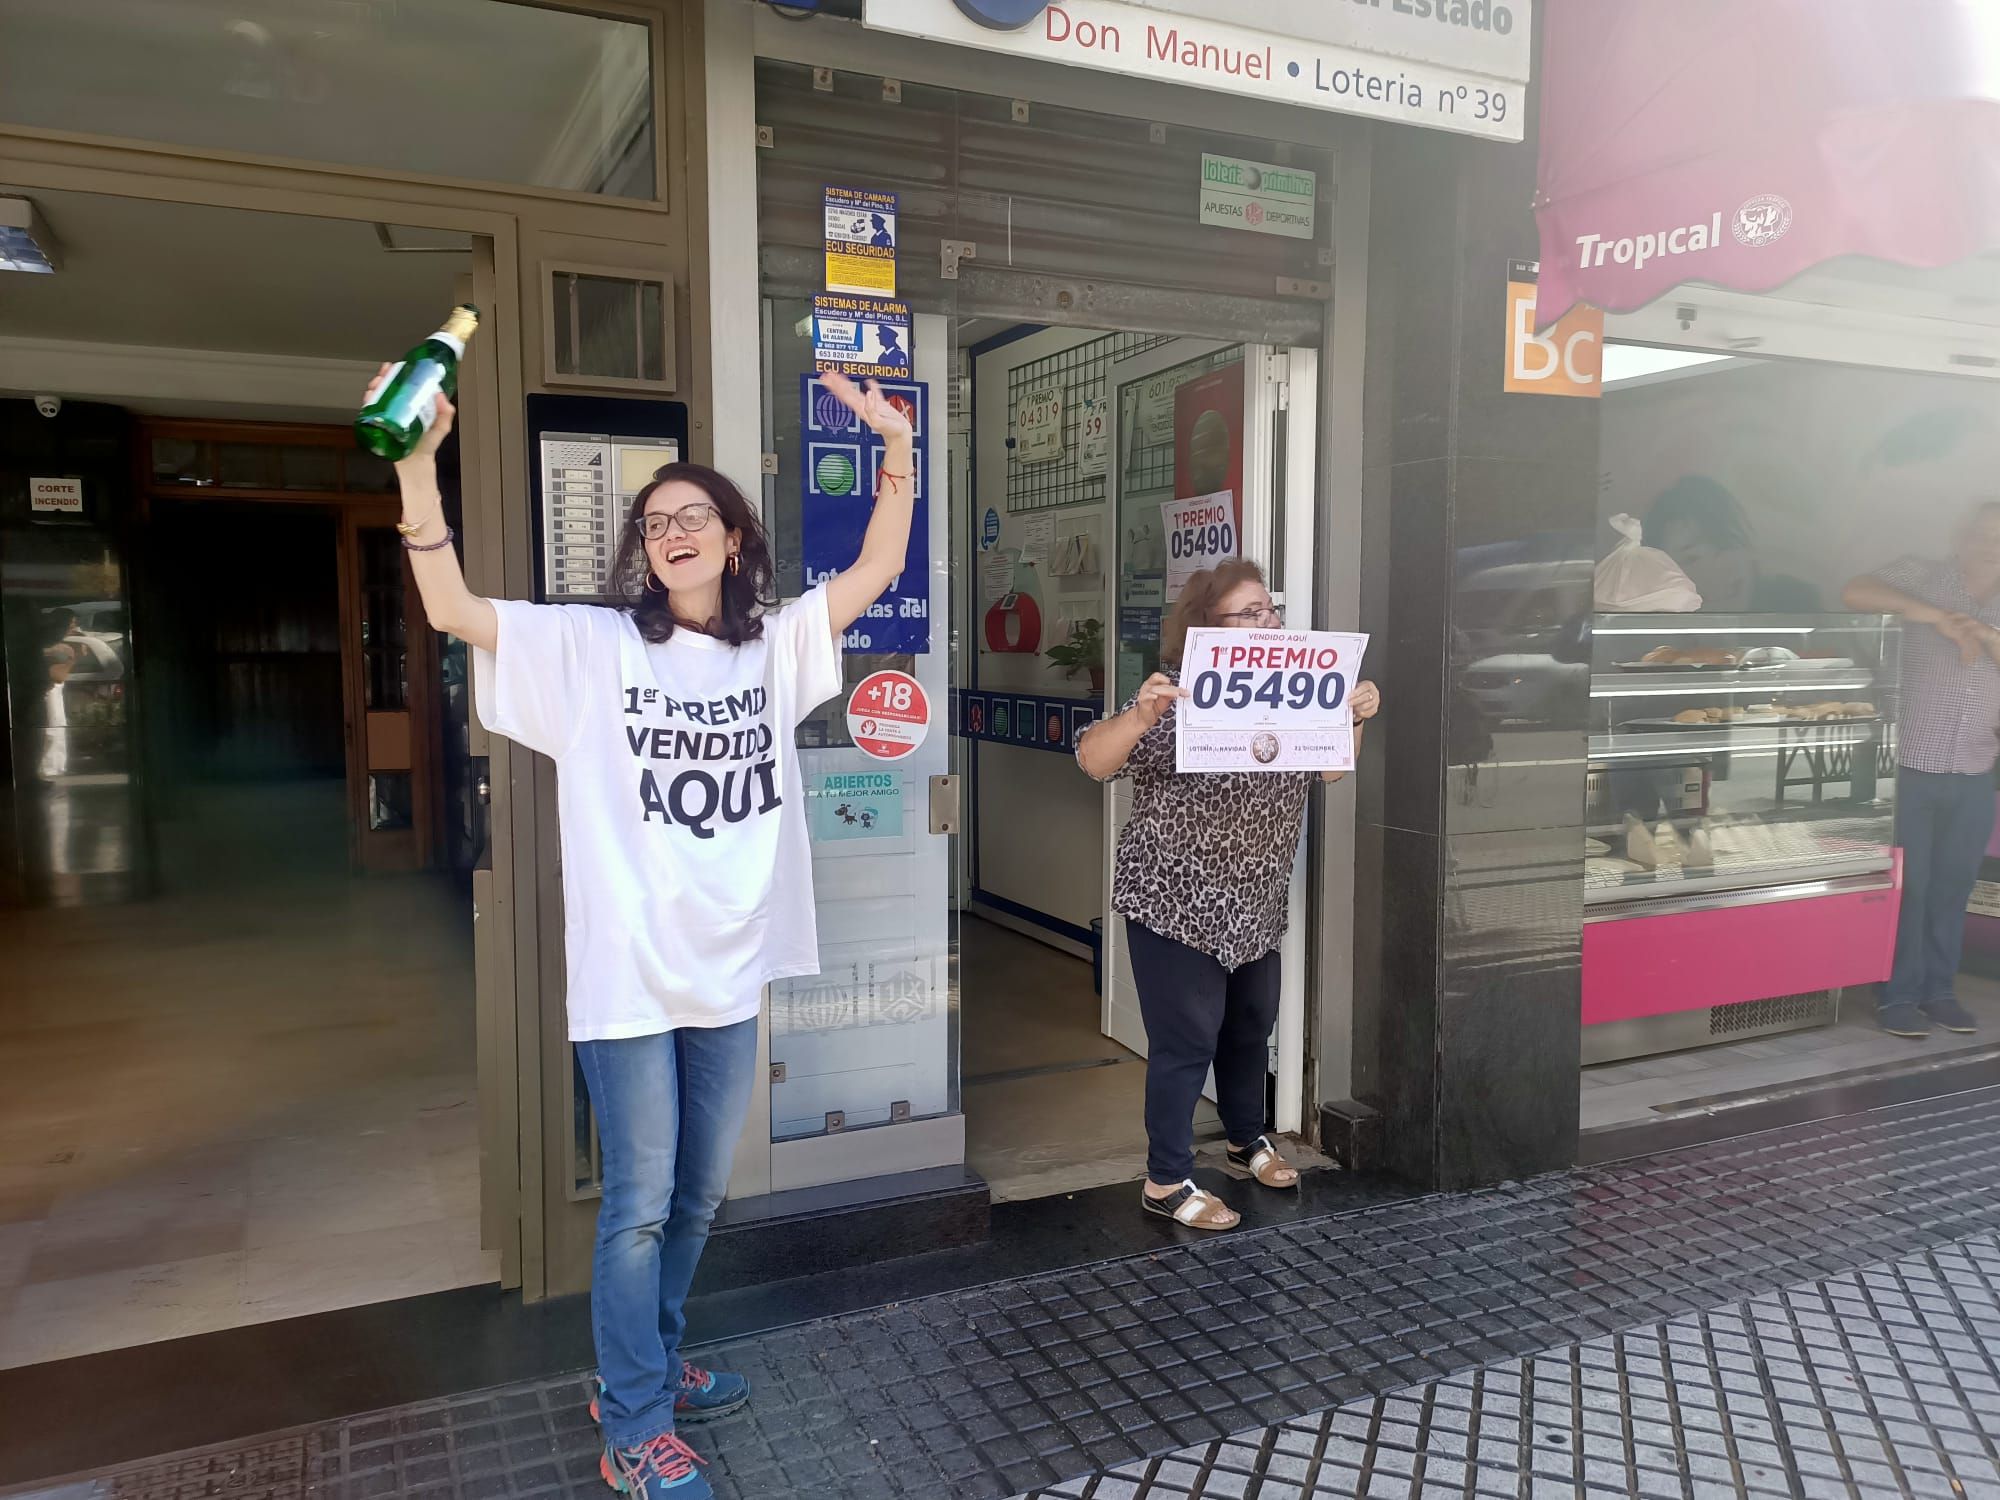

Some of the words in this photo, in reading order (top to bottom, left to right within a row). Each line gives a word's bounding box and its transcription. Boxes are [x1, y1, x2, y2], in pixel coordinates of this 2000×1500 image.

[1046, 5, 1120, 53] Don
[1146, 25, 1271, 81] Manuel
[1315, 58, 1422, 108] Loteria
[1474, 89, 1507, 122] 39
[825, 187, 853, 199] SISTEMA
[854, 191, 863, 200] DE
[863, 193, 895, 204] CAMARAS
[1204, 202, 1243, 217] APUESTAS
[1266, 211, 1310, 227] DEPORTIVAS
[826, 240, 843, 252] ECU
[845, 242, 895, 258] SEGURIDAD
[1576, 212, 1722, 269] Tropical
[814, 296, 857, 310] SISTEMAS
[859, 300, 871, 311] DE
[872, 302, 908, 314] ALARMA
[814, 307, 847, 317] Escudero
[848, 311, 853, 319] y
[864, 311, 875, 319] del
[816, 361, 839, 373] ECU
[842, 363, 909, 378] SEGURIDAD
[37, 485, 75, 493] CORTE
[34, 498, 79, 506] INCENDIO
[1182, 505, 1225, 528] PREMIO
[1171, 523, 1233, 559] 05490
[899, 598, 927, 618] del
[1248, 633, 1285, 641] VENDIDO
[1229, 646, 1338, 669] PREMIO
[867, 680, 913, 711] +18
[1192, 670, 1345, 710] 05490
[625, 722, 773, 761] VENDIDO
[824, 774, 892, 789] ABIERTOS
[639, 752, 783, 840] AQUÍ
[838, 789, 869, 798] MEJOR
[870, 788, 900, 796] AMIGO
